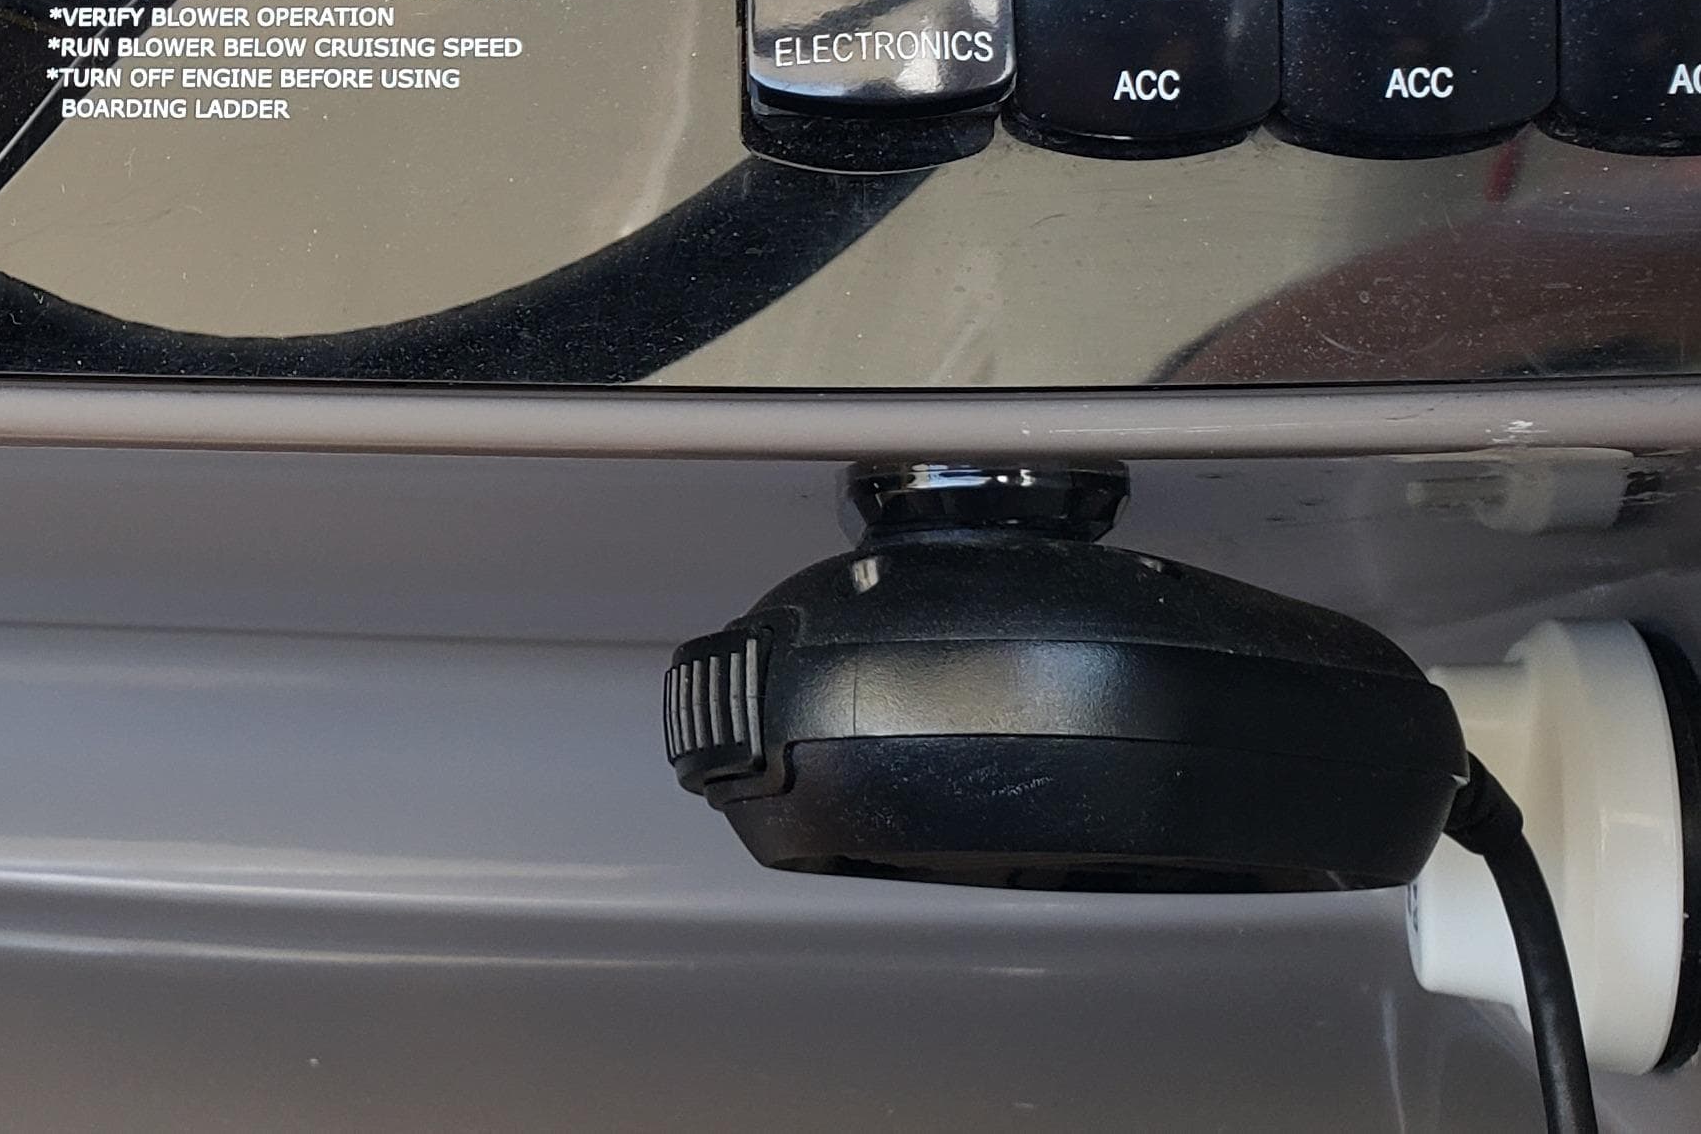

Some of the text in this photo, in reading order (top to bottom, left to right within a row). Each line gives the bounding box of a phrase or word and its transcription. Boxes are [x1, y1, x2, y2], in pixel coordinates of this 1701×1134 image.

[151, 7, 250, 27] BLOWER
[256, 7, 395, 27] OPERATION
[117, 37, 216, 58] BLOWER
[223, 37, 307, 57] BELOW
[314, 37, 436, 58] CRUISING
[442, 37, 523, 58] SPEED
[773, 29, 995, 66] ELECTRONICS
[129, 68, 175, 88] OFF
[181, 68, 273, 89] ENGINE
[280, 68, 374, 89] BEFORE
[380, 69, 461, 89] USING
[1112, 69, 1182, 102] ACC
[1385, 66, 1455, 99] ACC
[61, 99, 290, 120] BOARDING LADDER
